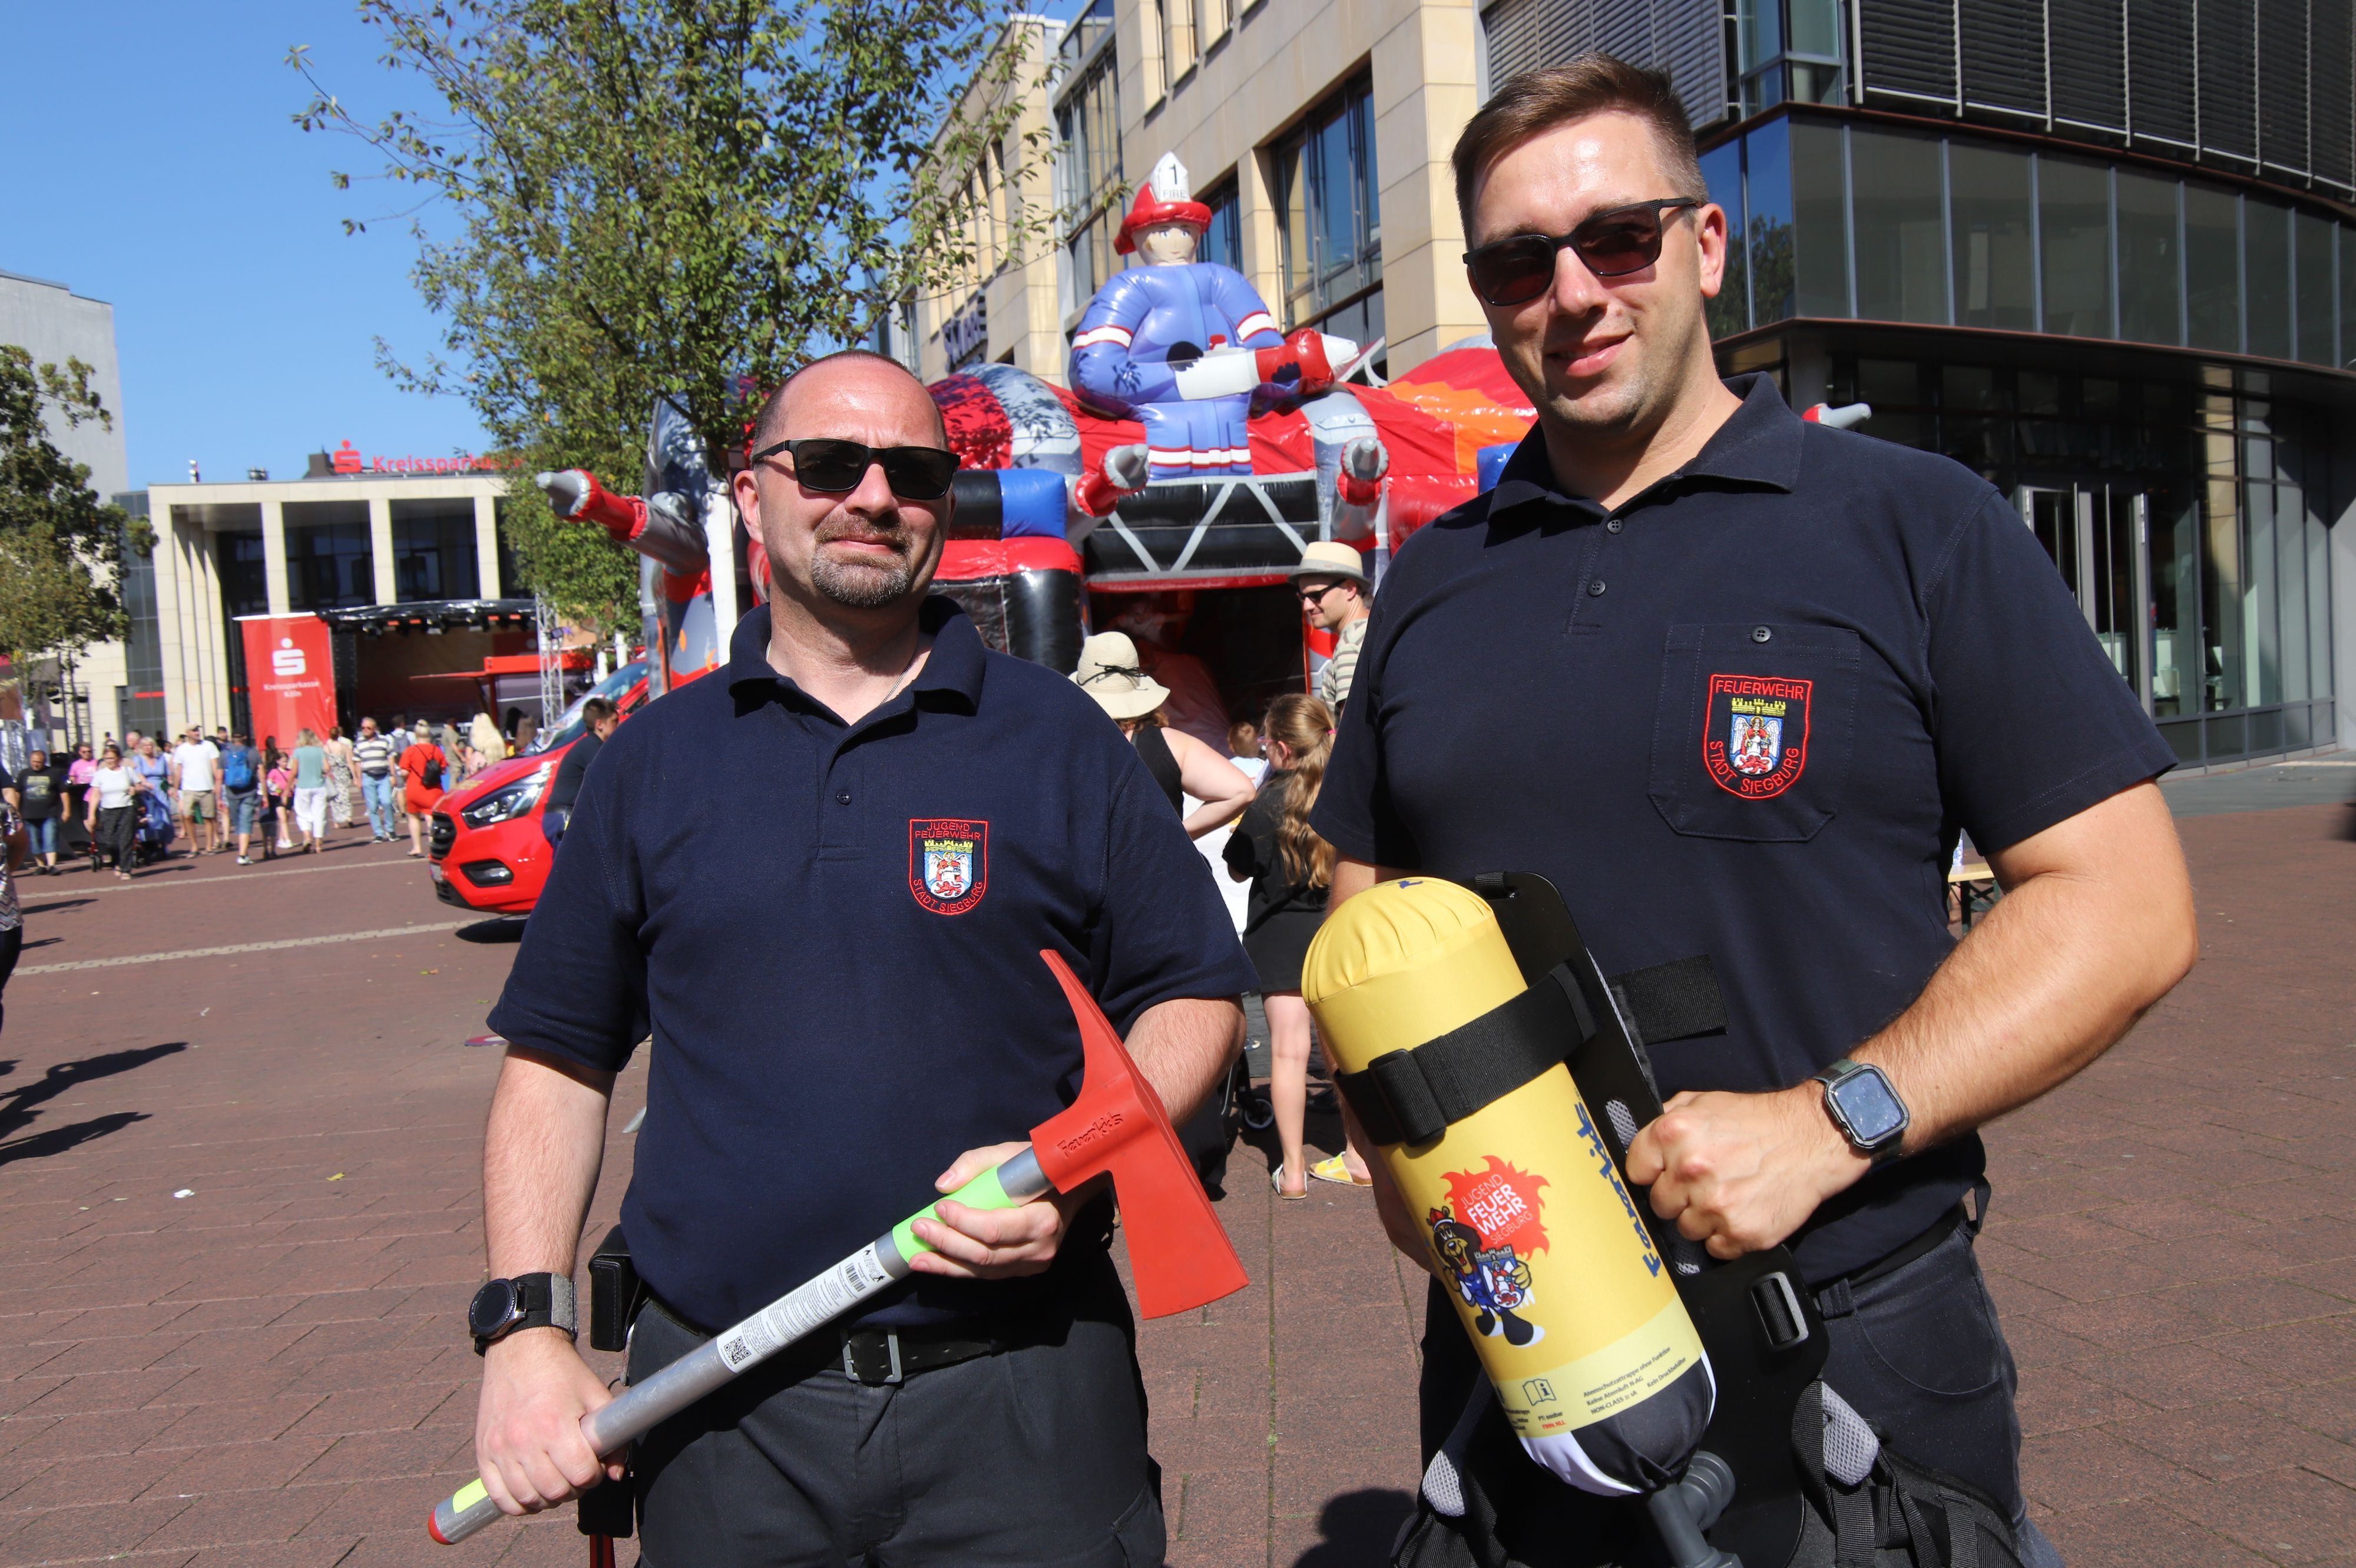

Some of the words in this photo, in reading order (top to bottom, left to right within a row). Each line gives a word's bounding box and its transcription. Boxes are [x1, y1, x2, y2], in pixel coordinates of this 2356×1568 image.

[1169, 164, 1177, 185] 1
[1163, 188, 1187, 198] FIRE
[1715, 680, 1805, 700] FEUERWEHR
[1709, 741, 1738, 783] STADT
[1740, 747, 1800, 794] SIEGBURG
[915, 830, 981, 840] FEUERWEHR
[926, 822, 971, 831] JUGEND
[914, 878, 938, 908] STADT
[939, 882, 983, 912] SIEGBURG
[1056, 1112, 1124, 1159] Feuerkids
[1461, 1174, 1503, 1209] JUGEND
[1467, 1183, 1517, 1223] FEUER
[1574, 1101, 1662, 1278] Feuerkids
[1477, 1196, 1528, 1236] WEHR
[1490, 1210, 1533, 1245] SIEGBURG
[862, 1253, 881, 1278] HERO
[1583, 1368, 1640, 1397] Atemschutzattrappe
[1639, 1360, 1652, 1371] ohne
[1652, 1347, 1671, 1362] Funktion
[1590, 1397, 1624, 1414] NON-CLASS
[1647, 1378, 1659, 1388] Kein
[1658, 1357, 1686, 1381] Druckbehälter
[1586, 1396, 1603, 1406] Keine
[1604, 1384, 1630, 1399] Atemluft
[1629, 1375, 1643, 1387] N-AG
